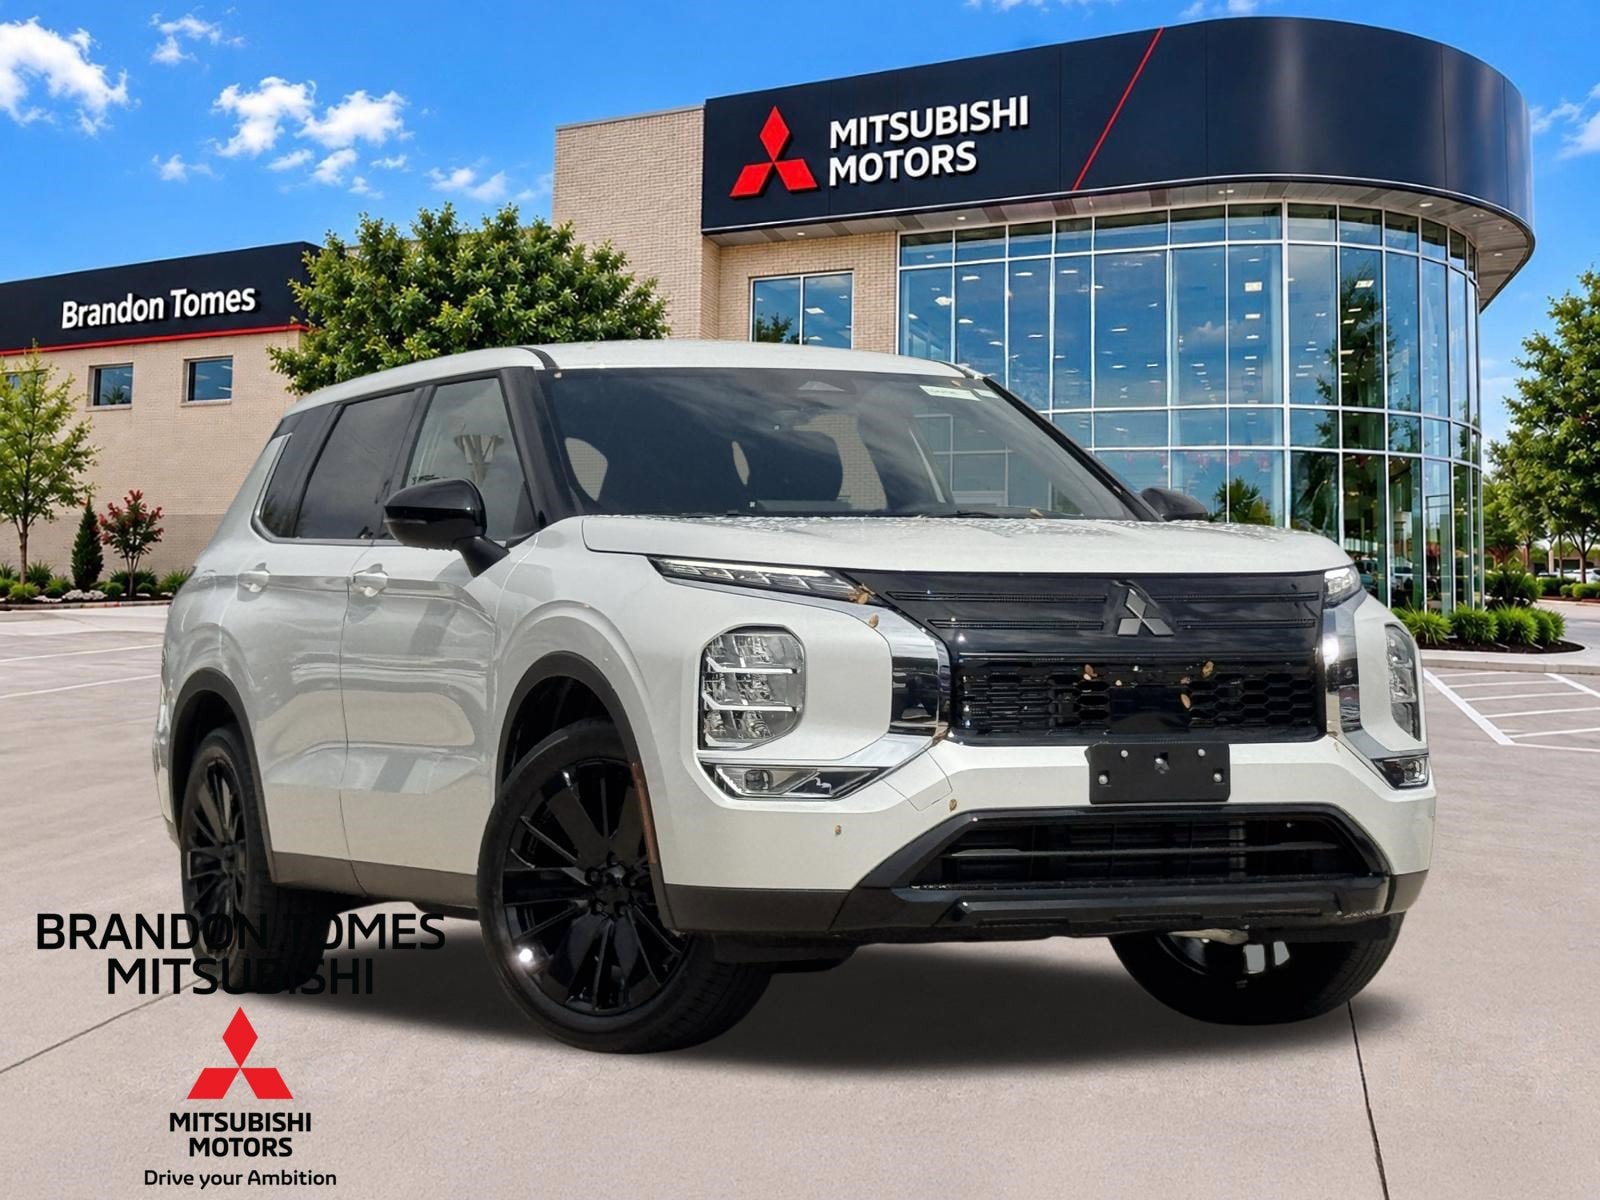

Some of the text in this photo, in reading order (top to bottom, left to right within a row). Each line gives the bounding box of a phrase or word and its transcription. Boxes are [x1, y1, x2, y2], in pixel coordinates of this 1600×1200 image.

[829, 95, 1029, 149] MITSUBISHI
[829, 140, 977, 187] MOTORS
[61, 287, 256, 329] Brandon Tomes
